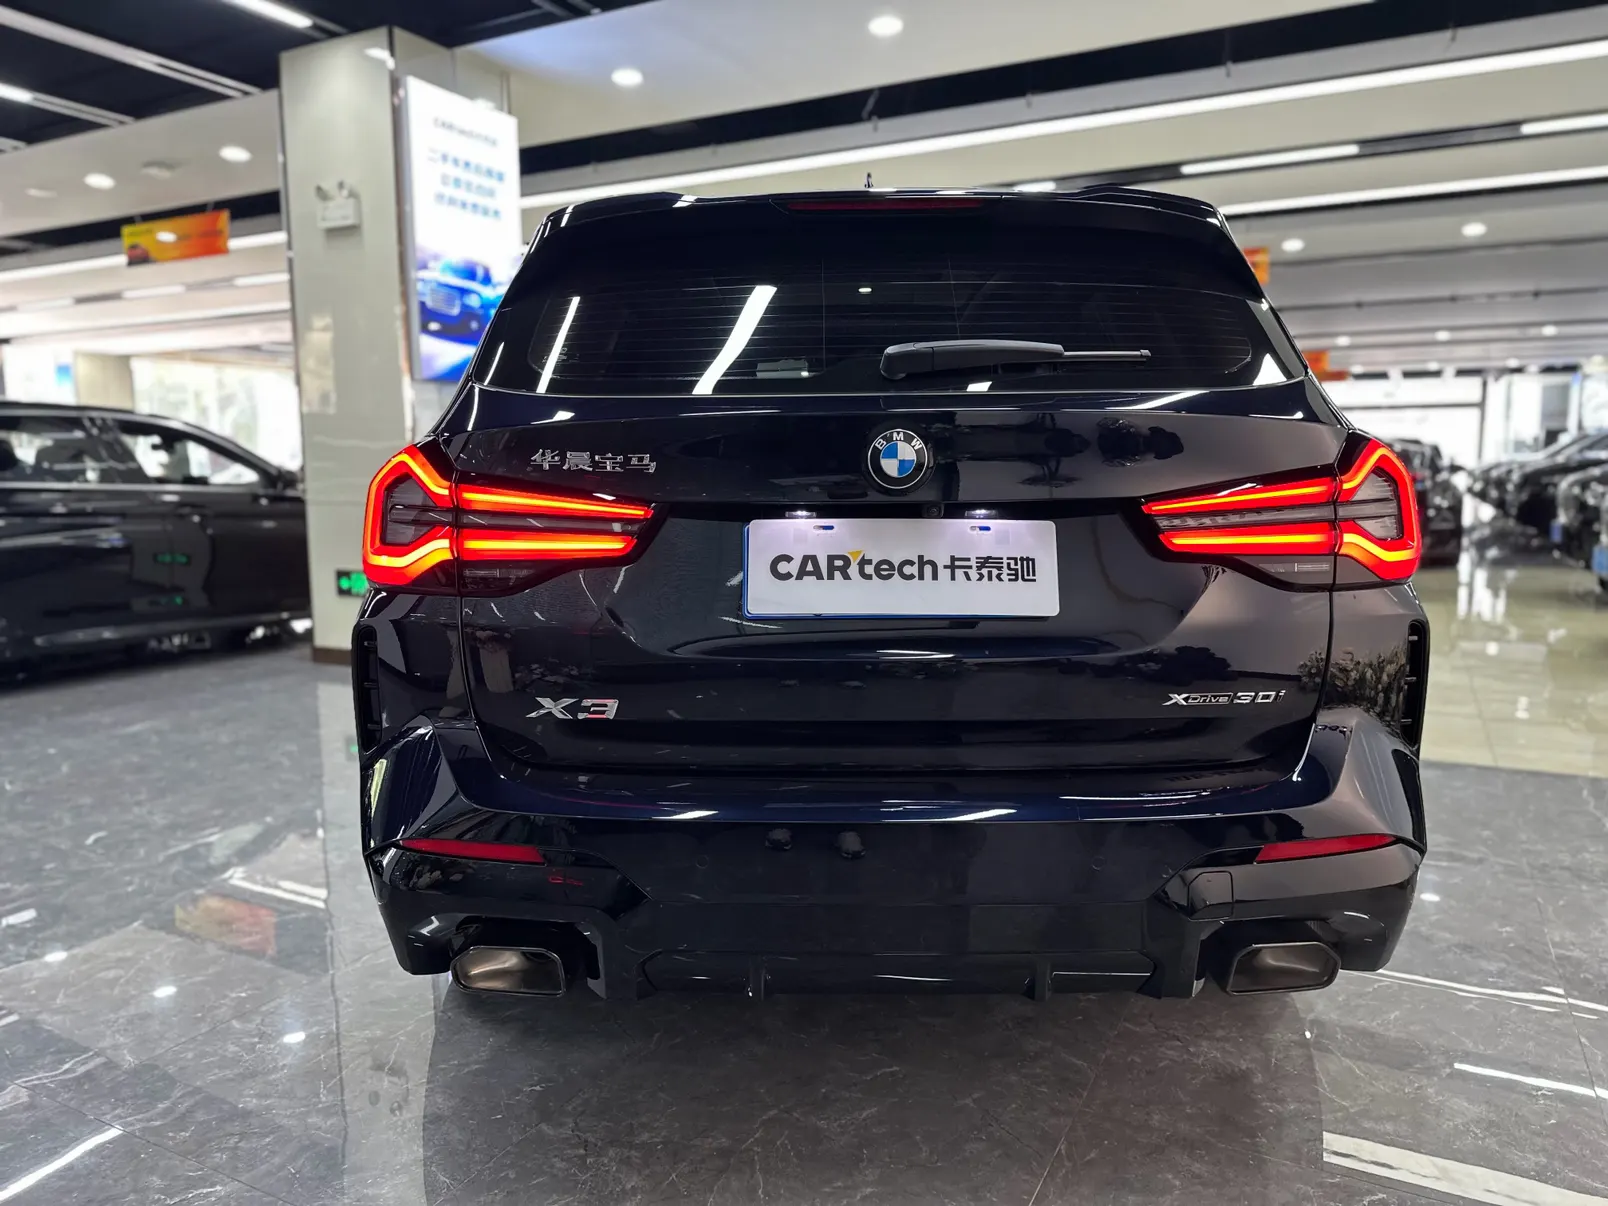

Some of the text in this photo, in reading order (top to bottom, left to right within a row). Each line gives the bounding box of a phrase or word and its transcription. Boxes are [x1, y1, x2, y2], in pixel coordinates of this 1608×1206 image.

[875, 432, 922, 450] BMW
[530, 449, 657, 473] 华晨宝马
[769, 550, 1037, 582] CARtech 卡泰驰
[525, 697, 619, 720] X3
